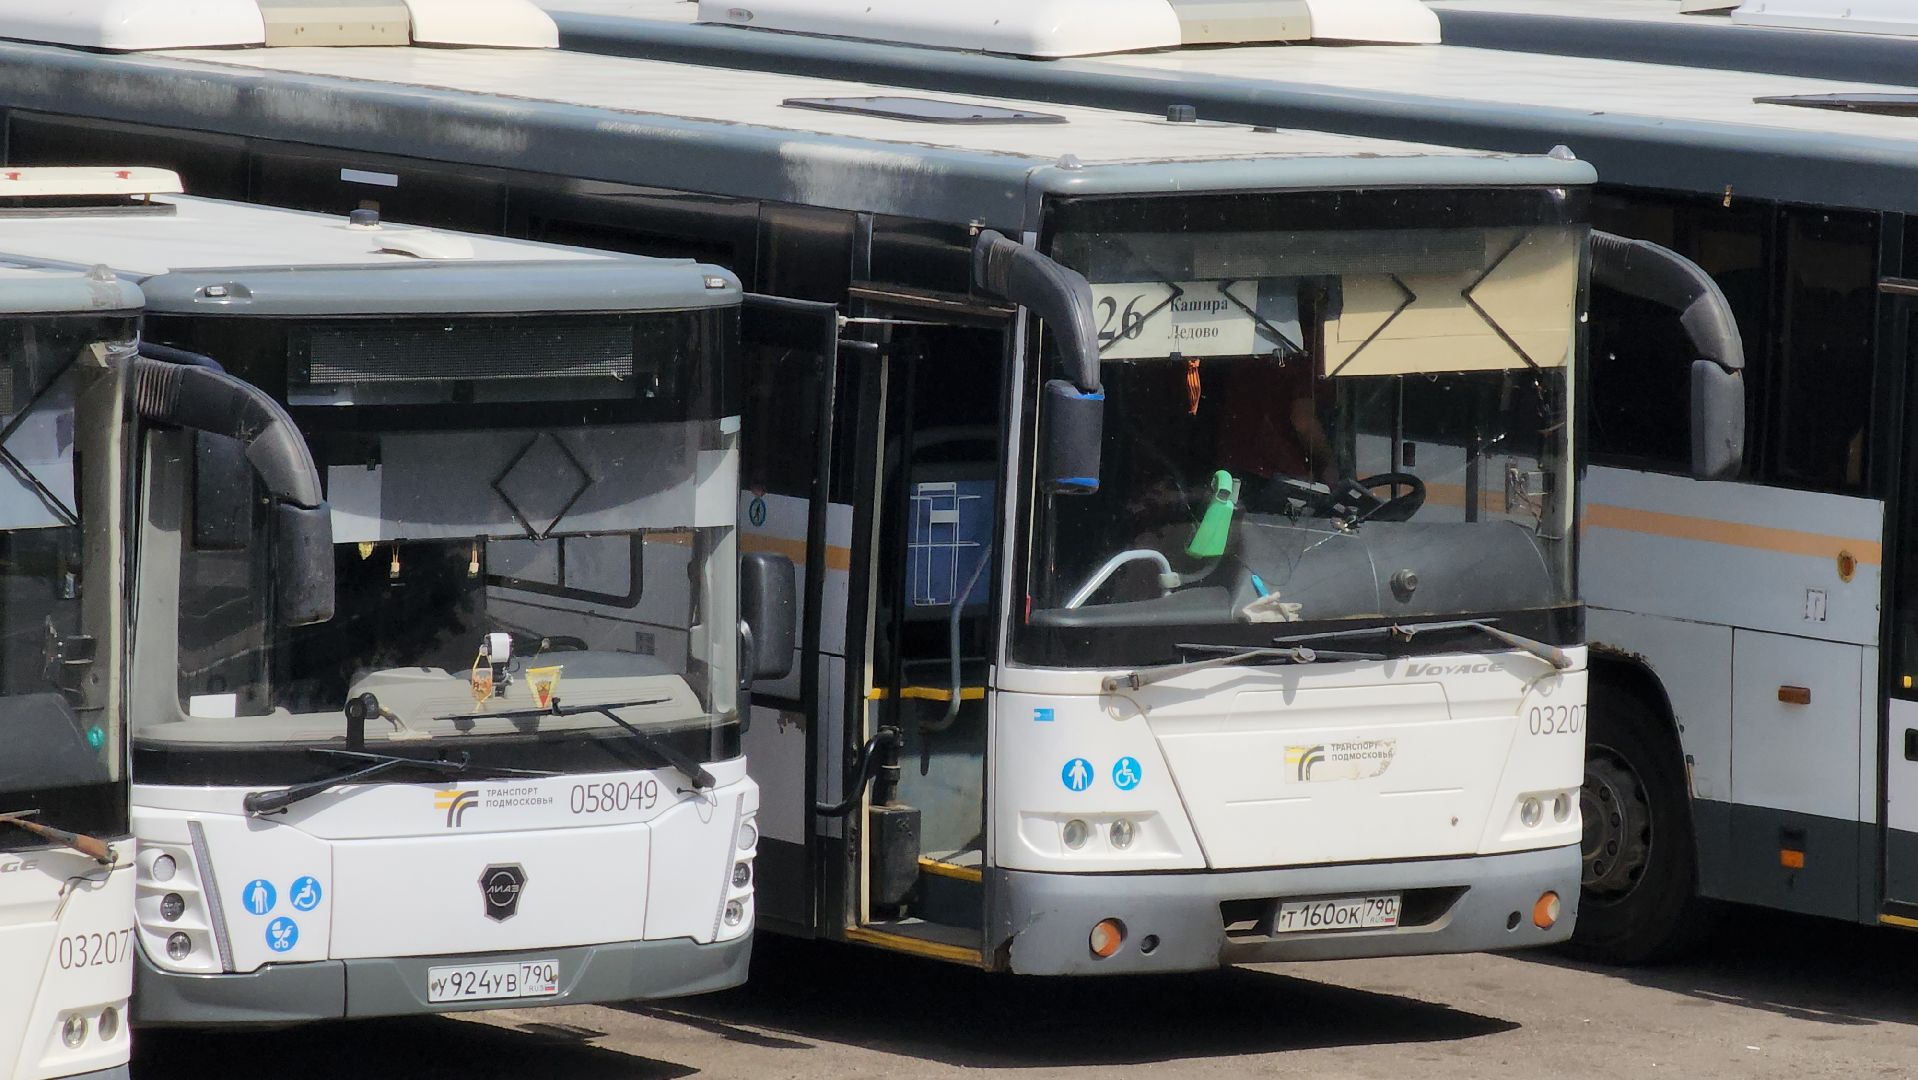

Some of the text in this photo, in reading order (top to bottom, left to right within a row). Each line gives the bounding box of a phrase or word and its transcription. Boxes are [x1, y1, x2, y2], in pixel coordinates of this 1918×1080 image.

[1170, 297, 1228, 315] Кашира
[1168, 324, 1219, 340] Ледово
[1330, 742, 1379, 751] ТРАНСПОРТ
[486, 787, 538, 797] ТРАНСПОРТ
[570, 779, 658, 814] 058049
[1286, 898, 1394, 928] Т160ОК 790
[437, 964, 553, 998] У924УВ 790
